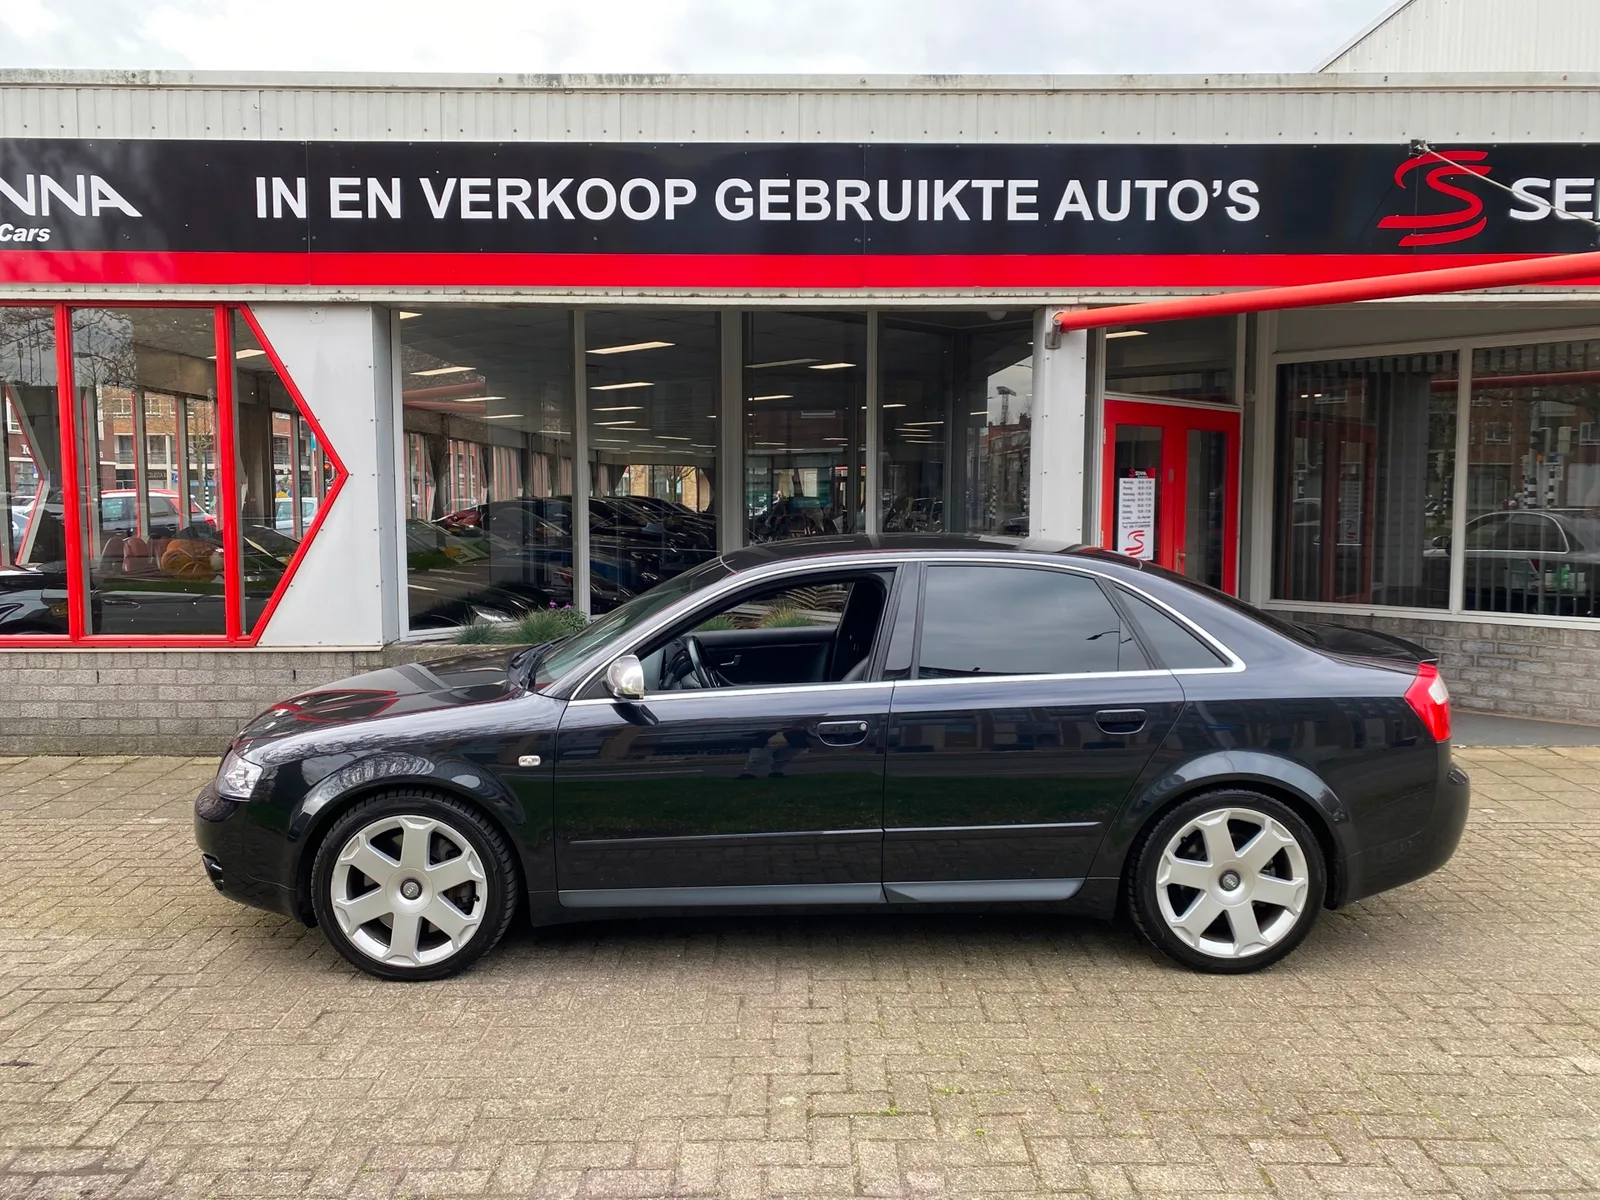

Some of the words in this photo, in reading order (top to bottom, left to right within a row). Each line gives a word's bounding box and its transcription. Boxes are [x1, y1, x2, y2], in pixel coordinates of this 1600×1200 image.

[255, 176, 307, 219] IN
[329, 177, 402, 219] EN
[419, 177, 697, 221] VERKOOP
[714, 178, 1039, 222] GEBRUIKTE
[1053, 178, 1260, 222] AUTO’S
[1509, 176, 1600, 221] SE
[0, 223, 51, 242] Cars
